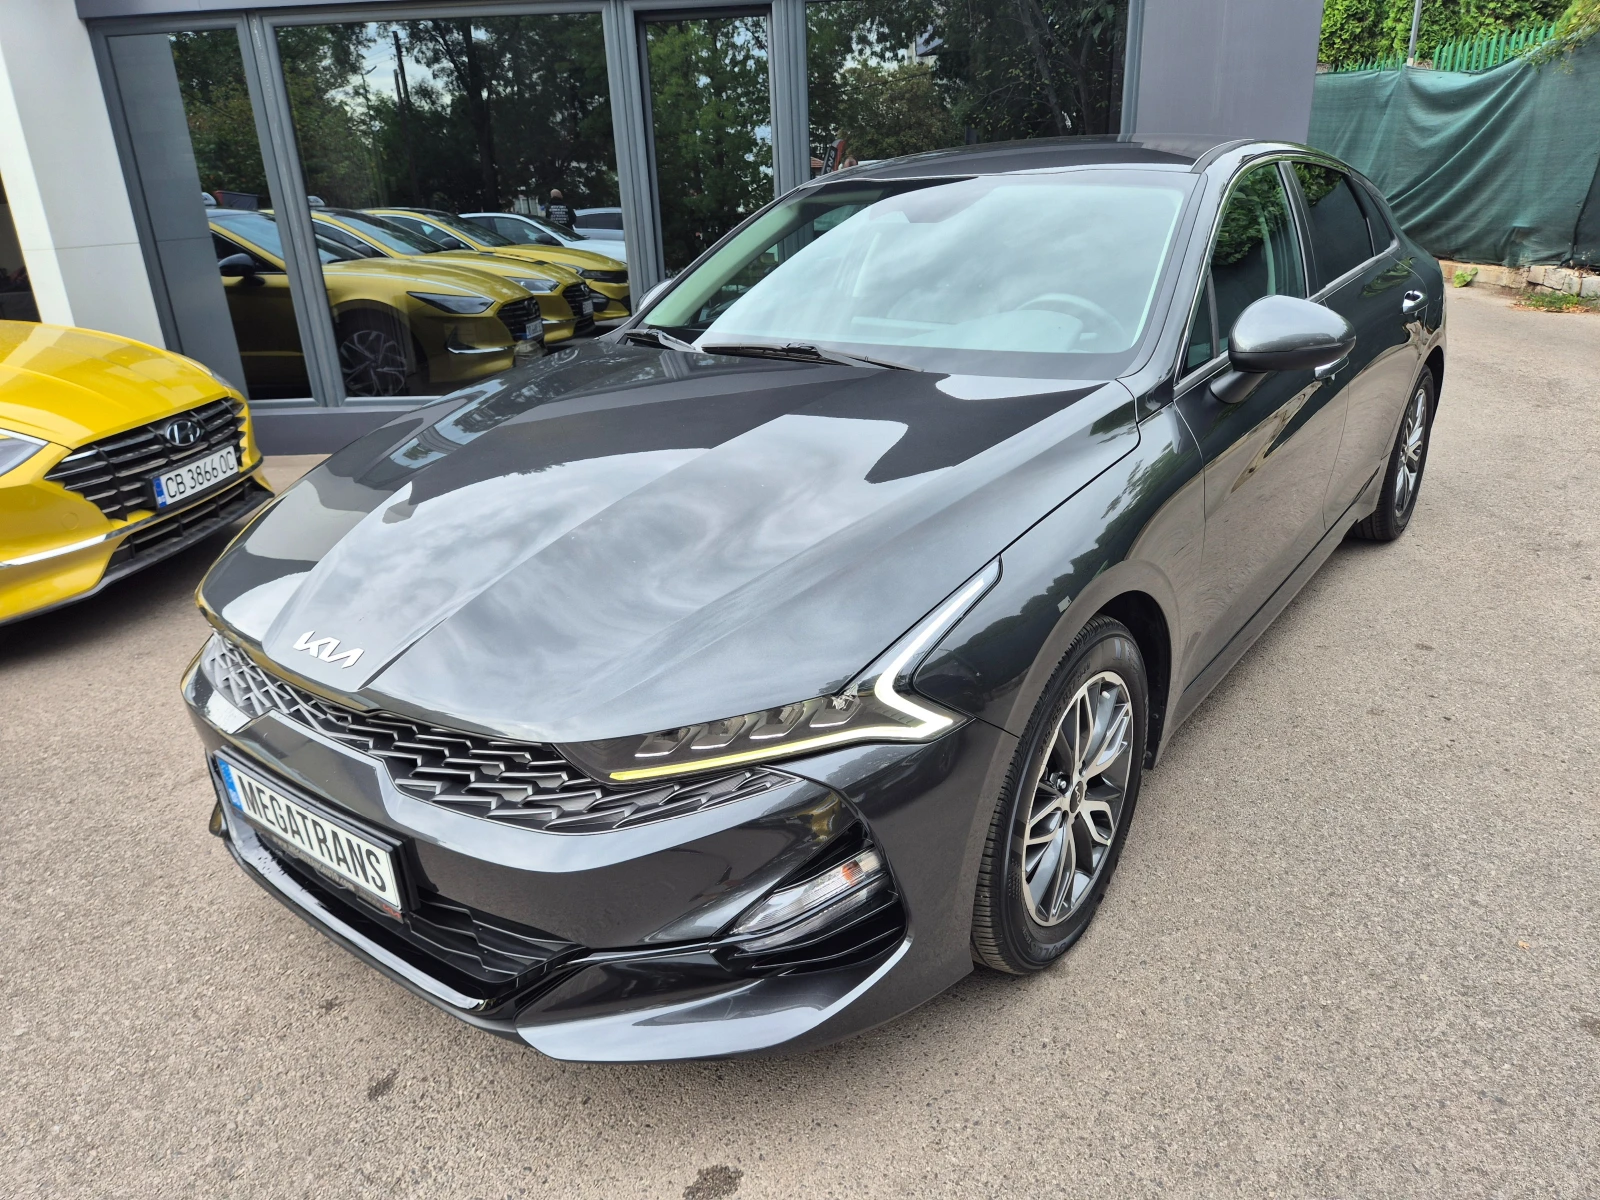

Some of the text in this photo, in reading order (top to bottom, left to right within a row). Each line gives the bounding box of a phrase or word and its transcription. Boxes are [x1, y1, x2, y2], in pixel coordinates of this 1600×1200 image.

[165, 473, 187, 498] CB
[187, 458, 219, 489] 3866
[292, 630, 365, 669] KIA
[236, 773, 387, 893] MEGATRANS
